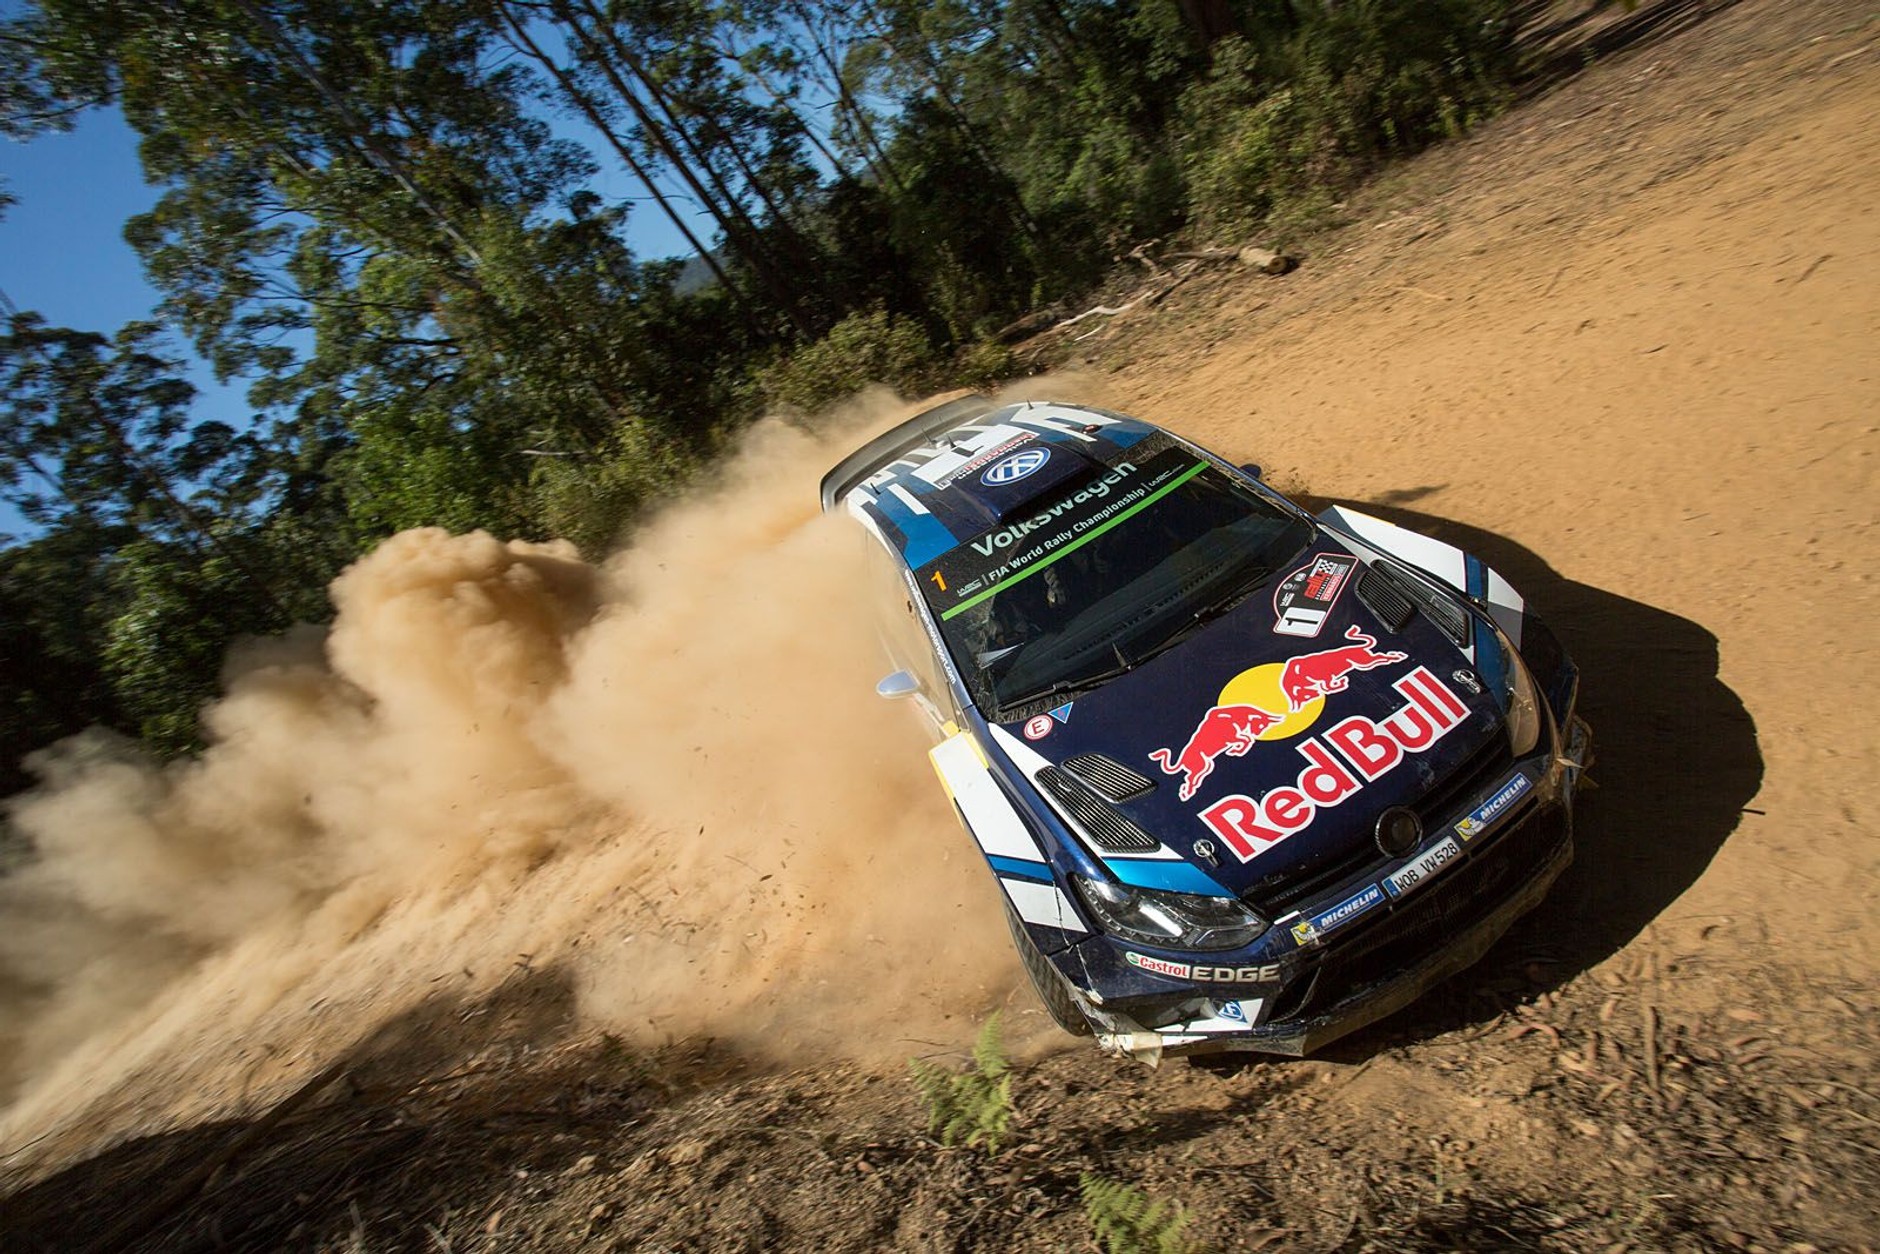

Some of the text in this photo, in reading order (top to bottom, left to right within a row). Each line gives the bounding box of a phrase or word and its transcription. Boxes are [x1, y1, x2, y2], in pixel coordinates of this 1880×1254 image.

[971, 461, 1137, 557] Volkswagen
[989, 565, 1010, 581] FIA
[1009, 546, 1043, 569] World
[1044, 530, 1074, 550] Rally
[1073, 487, 1145, 533] Championship
[931, 570, 947, 592] 1
[1285, 616, 1319, 626] 1
[1032, 719, 1044, 735] E
[1204, 669, 1466, 858] Red Bull
[1480, 777, 1526, 819] MICHELIN
[1394, 869, 1419, 891] WOB
[1320, 889, 1379, 927] MICHELIN
[1140, 957, 1281, 982] Castrol EDGE
